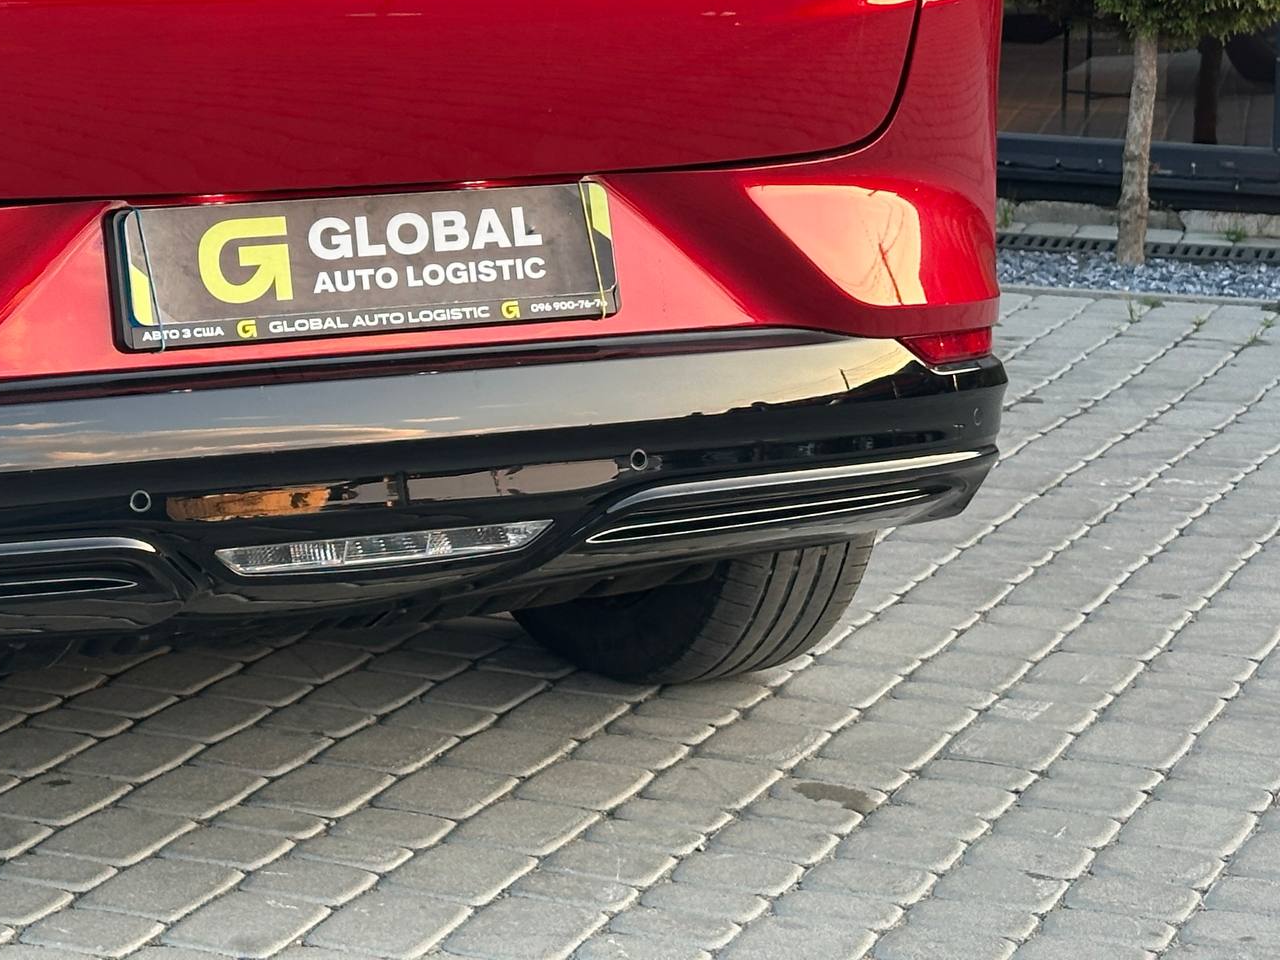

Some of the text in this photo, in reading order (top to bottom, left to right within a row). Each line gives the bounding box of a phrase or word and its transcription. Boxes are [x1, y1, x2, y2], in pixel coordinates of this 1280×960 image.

[308, 206, 543, 260] GLOBAL
[313, 256, 547, 294] AUTO LOGISTIC
[268, 305, 491, 334] GLOBAL AUTO LOGISTIC
[530, 302, 553, 313] 096
[142, 329, 180, 342] АВТО
[193, 326, 225, 338] США
